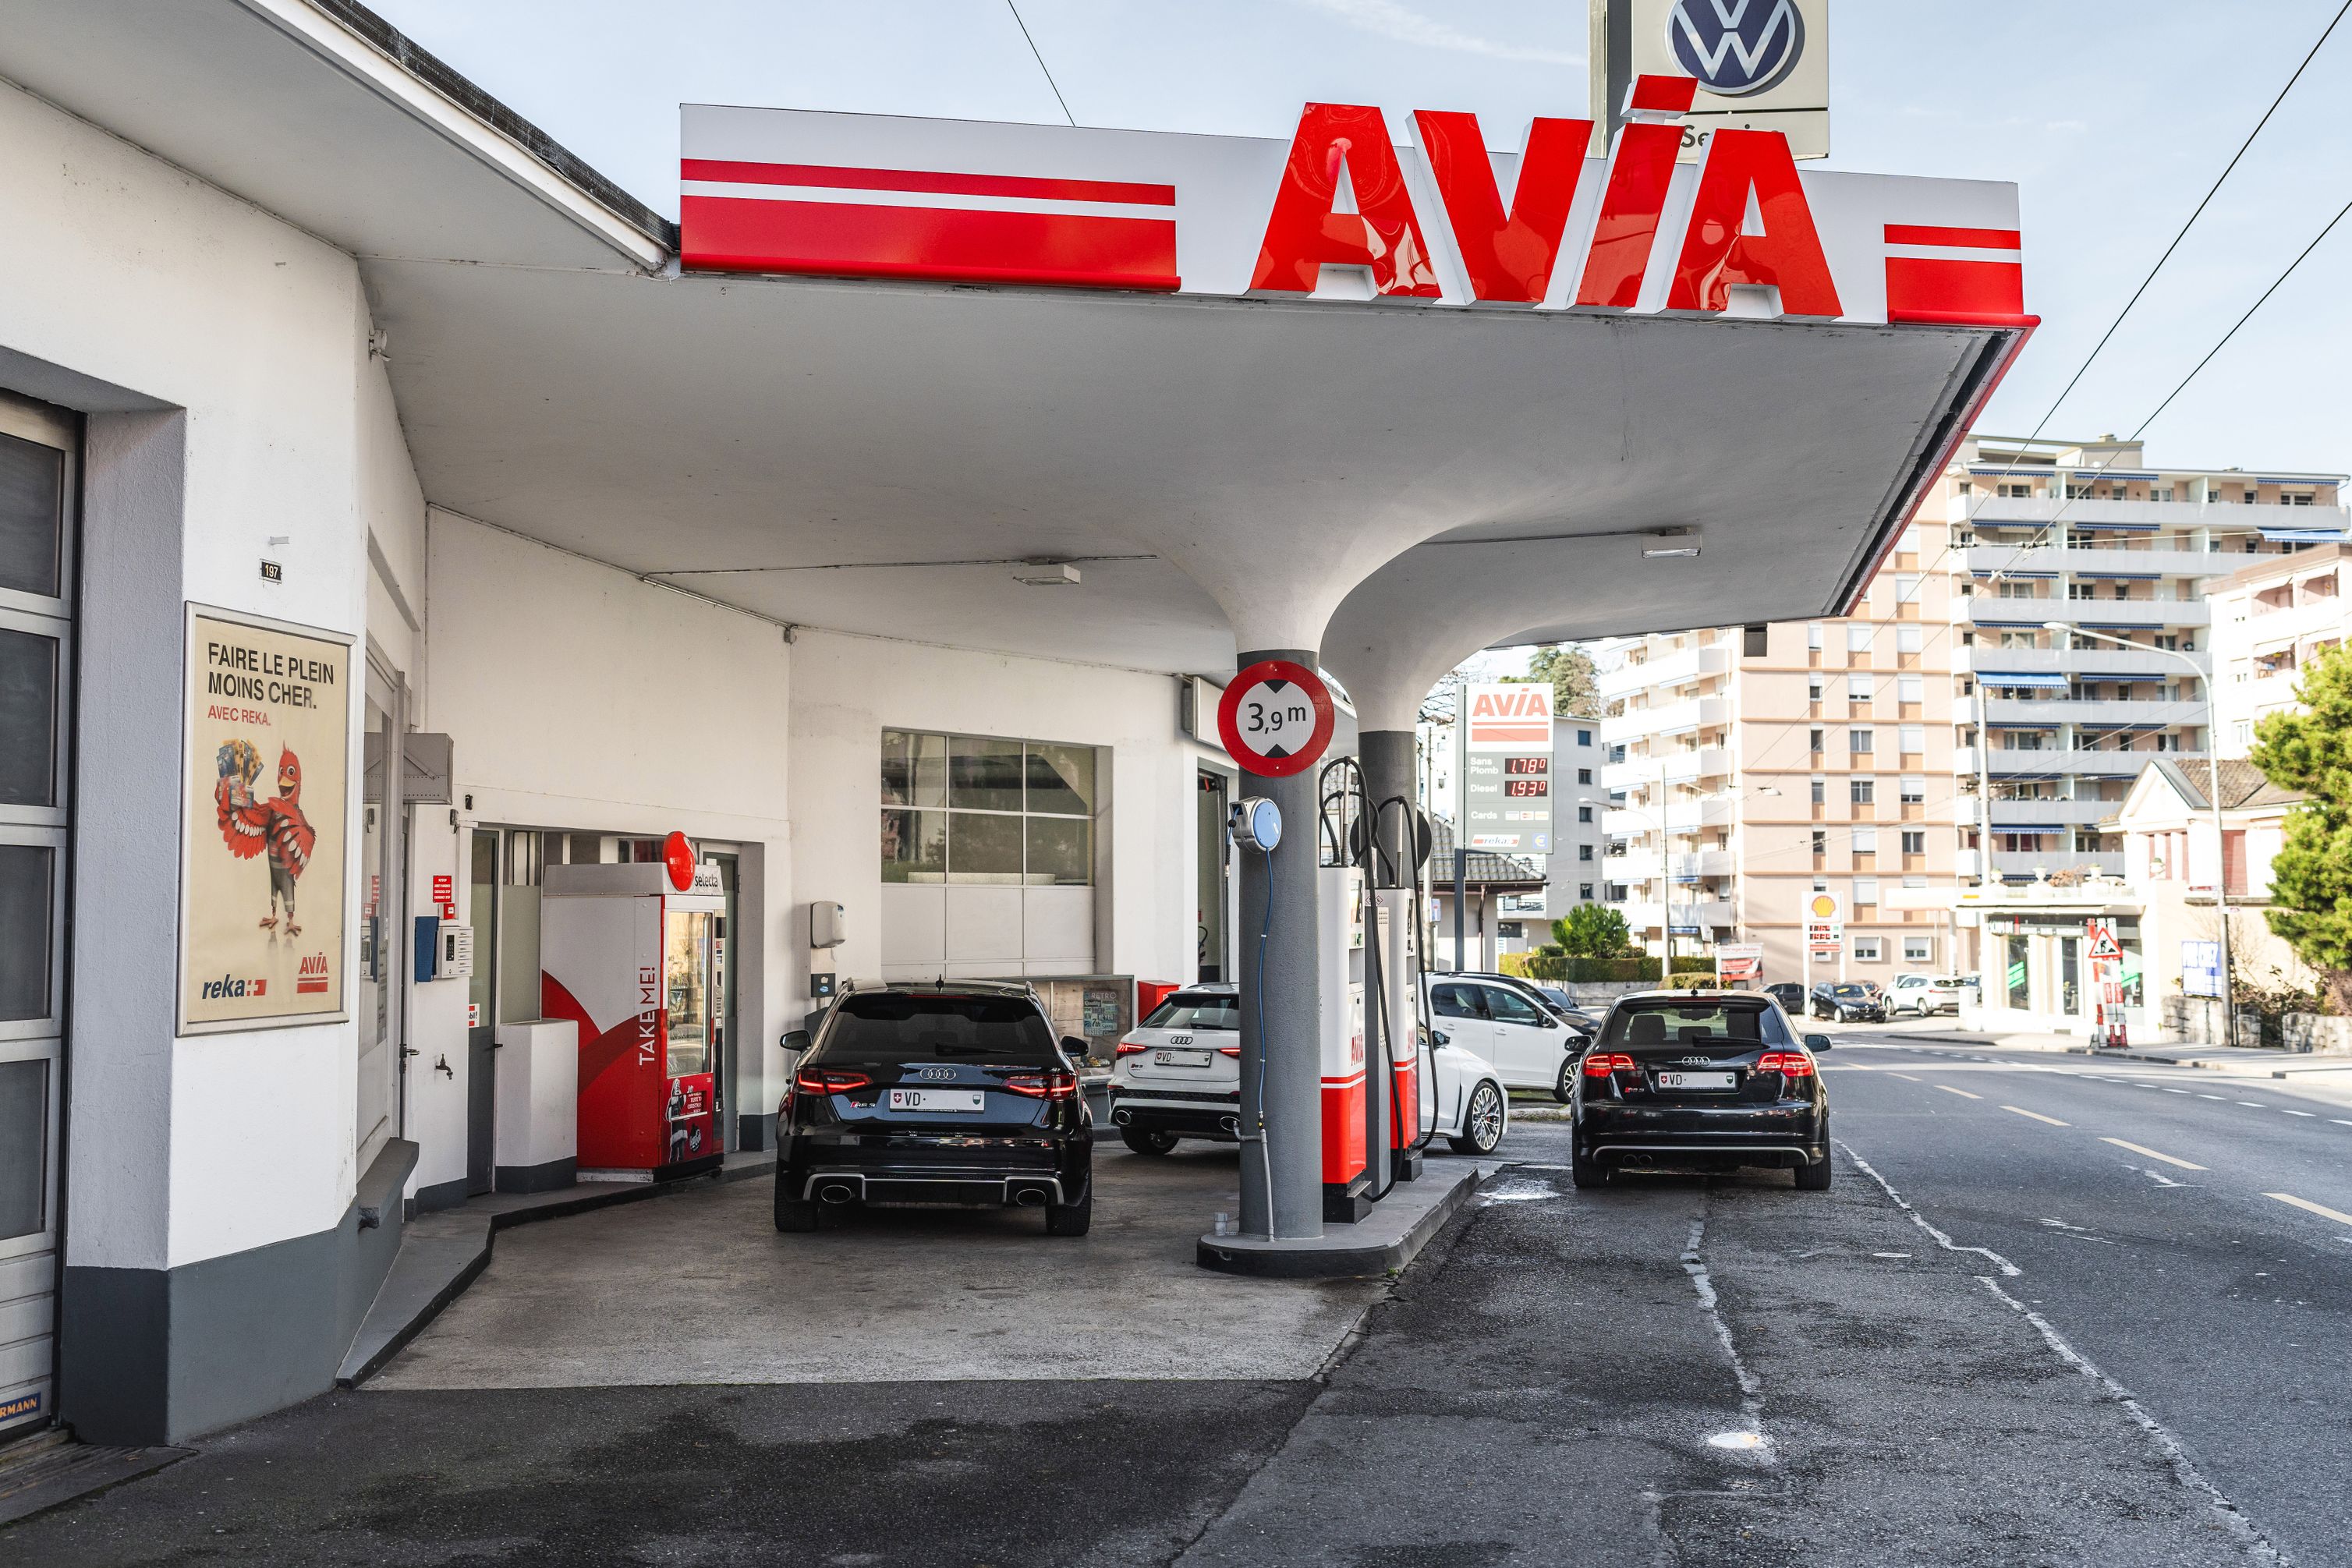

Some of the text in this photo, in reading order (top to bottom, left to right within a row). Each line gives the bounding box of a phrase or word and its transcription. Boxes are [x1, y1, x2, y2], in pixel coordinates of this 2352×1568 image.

[265, 565, 278, 578] 197
[208, 642, 334, 685] FAIRE LE PLEIN
[208, 671, 317, 710] MOINS CHER.
[207, 705, 271, 726] AVEC REKA.
[1470, 757, 1493, 766] Sans
[1470, 766, 1499, 774] Plomb
[1470, 784, 1498, 793] Diesel
[1471, 811, 1497, 819] Cards
[694, 874, 718, 888] selecta
[639, 966, 655, 1067] TAKE ME!
[1161, 1053, 1171, 1061] VD
[1669, 1074, 1682, 1085] VD
[905, 1092, 920, 1106] VD
